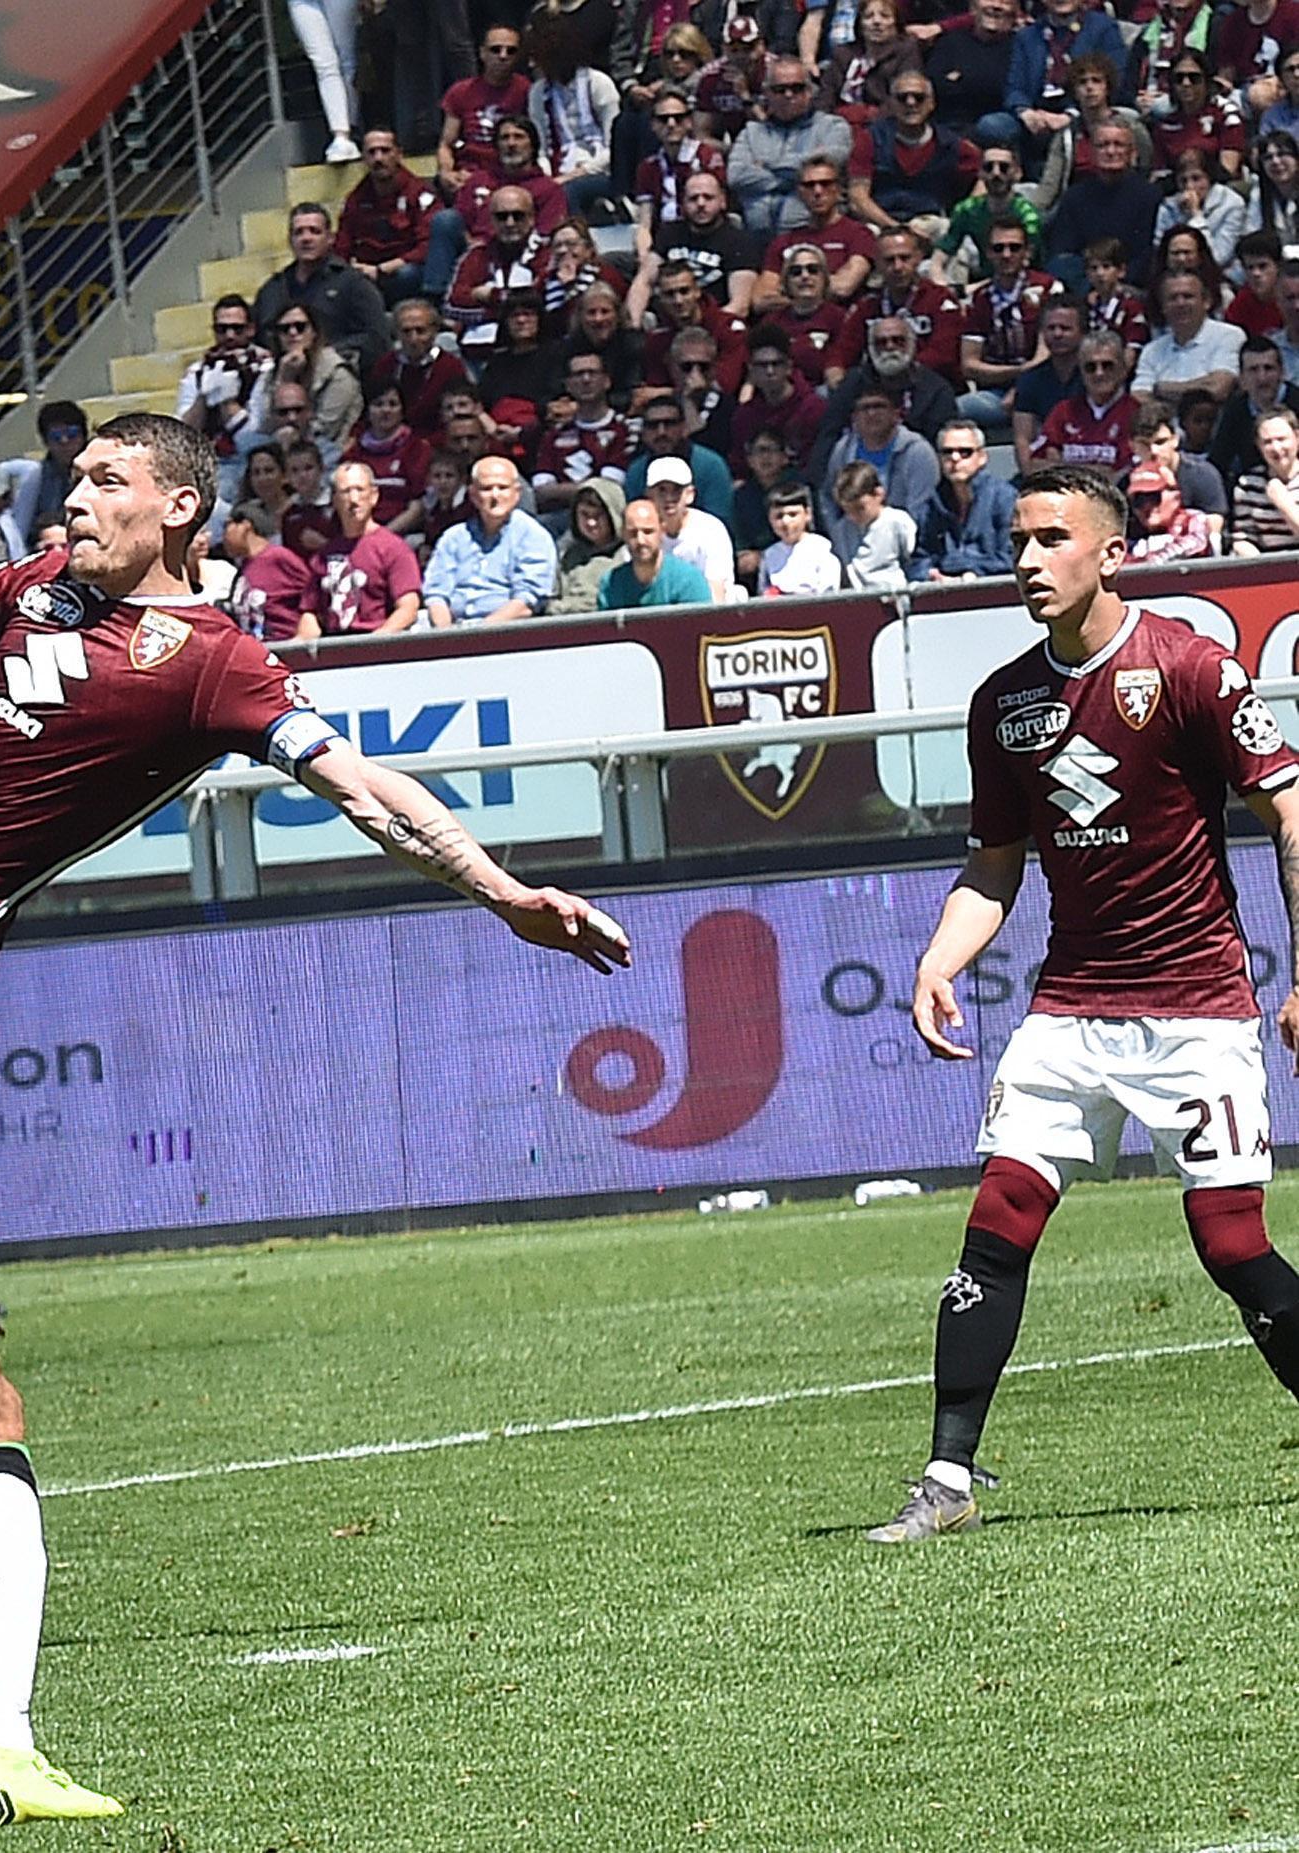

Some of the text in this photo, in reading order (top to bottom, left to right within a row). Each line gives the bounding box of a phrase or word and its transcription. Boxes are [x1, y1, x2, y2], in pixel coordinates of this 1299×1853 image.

[714, 645, 819, 678] TORINO
[783, 684, 822, 713] FC
[1176, 1095, 1241, 1162] 21
